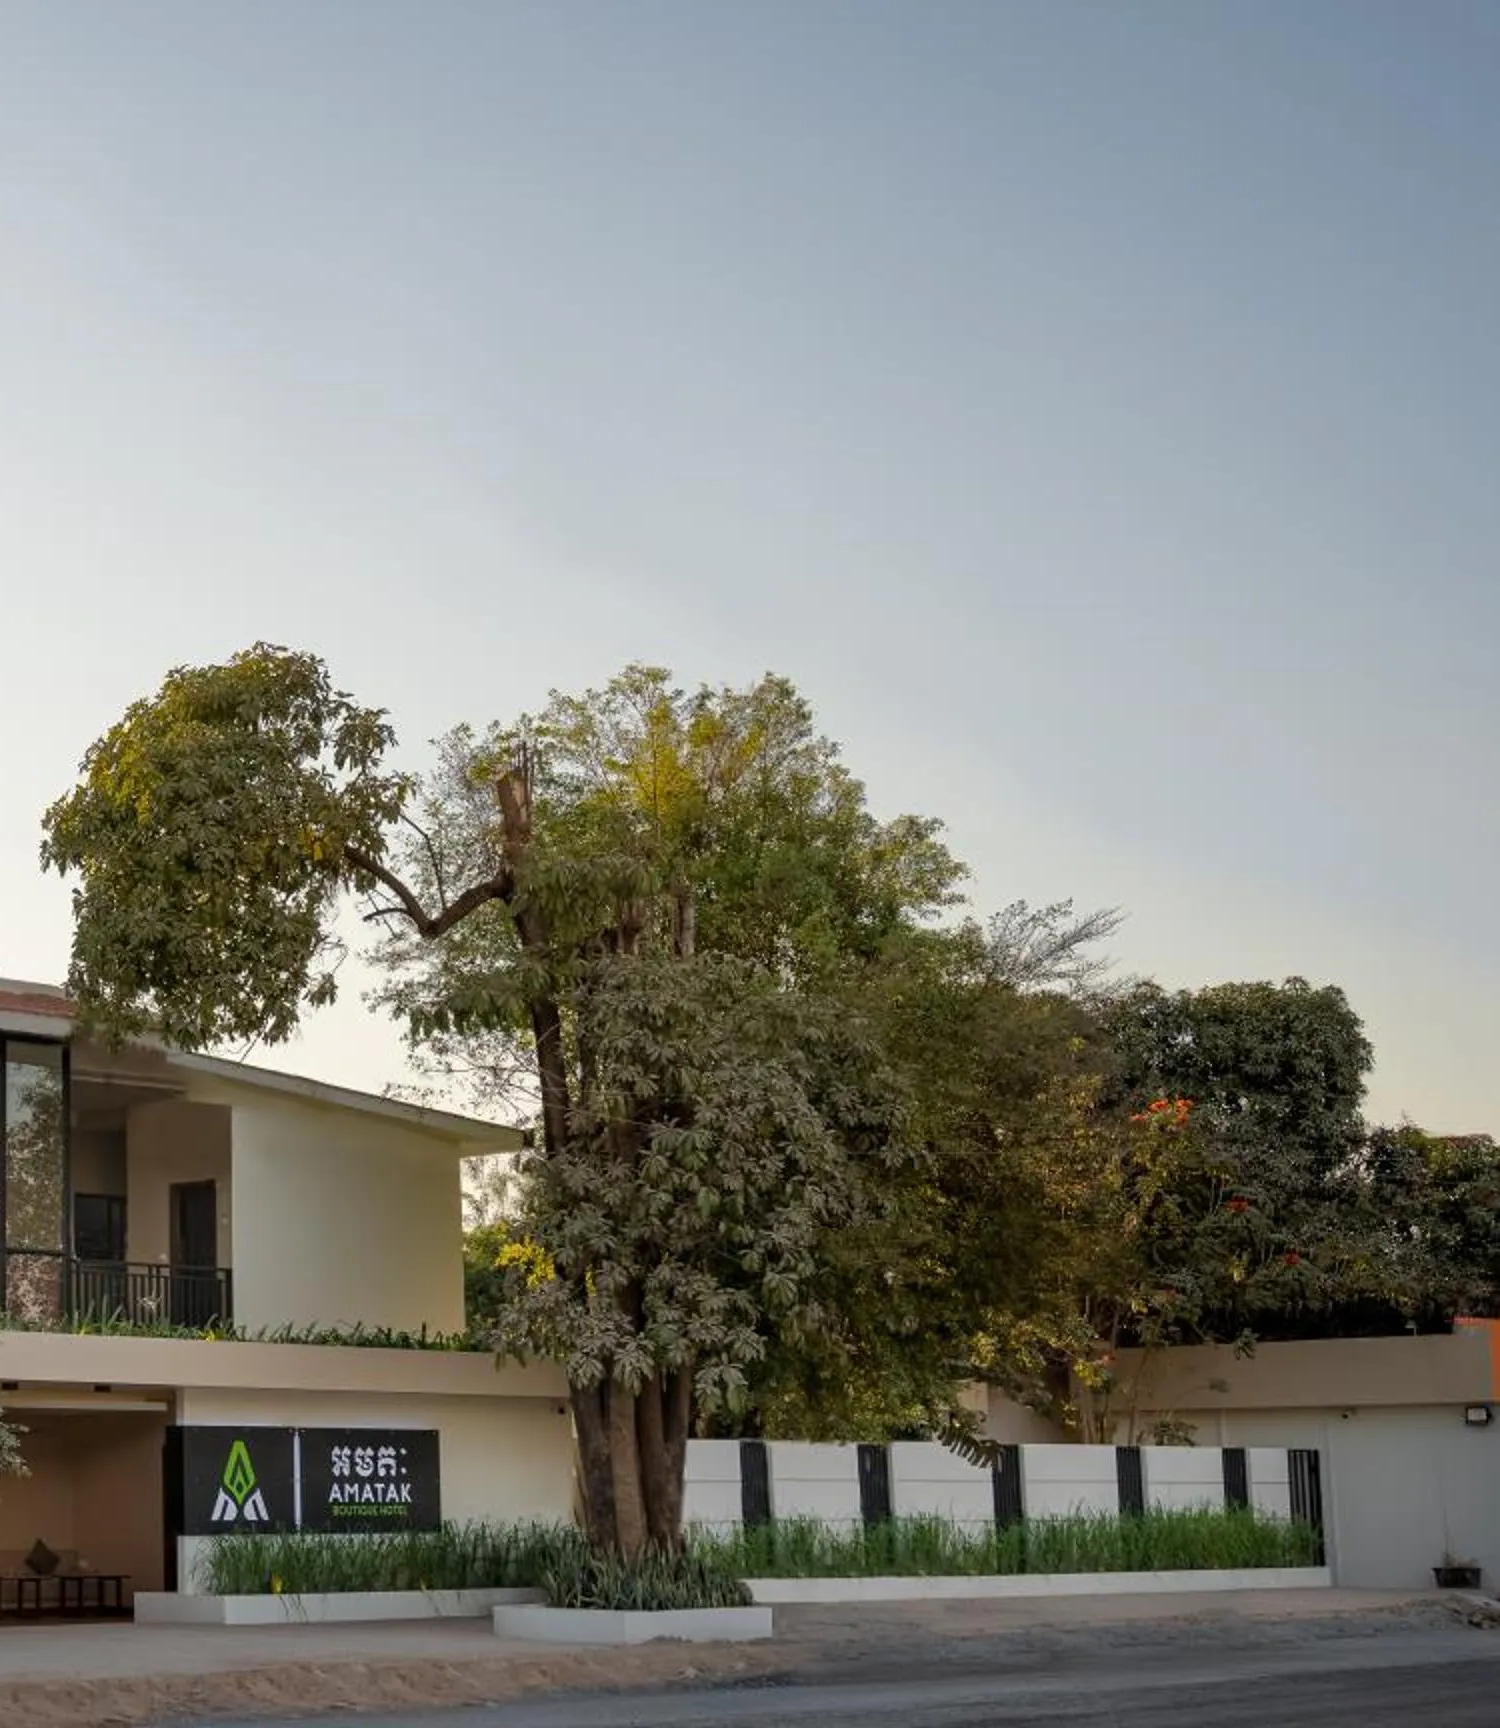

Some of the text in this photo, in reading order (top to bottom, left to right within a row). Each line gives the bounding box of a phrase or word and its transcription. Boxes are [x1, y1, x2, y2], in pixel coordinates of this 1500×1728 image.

[329, 1482, 412, 1503] AMATAK
[332, 1505, 408, 1516] BOUTIQUE HOTEL
